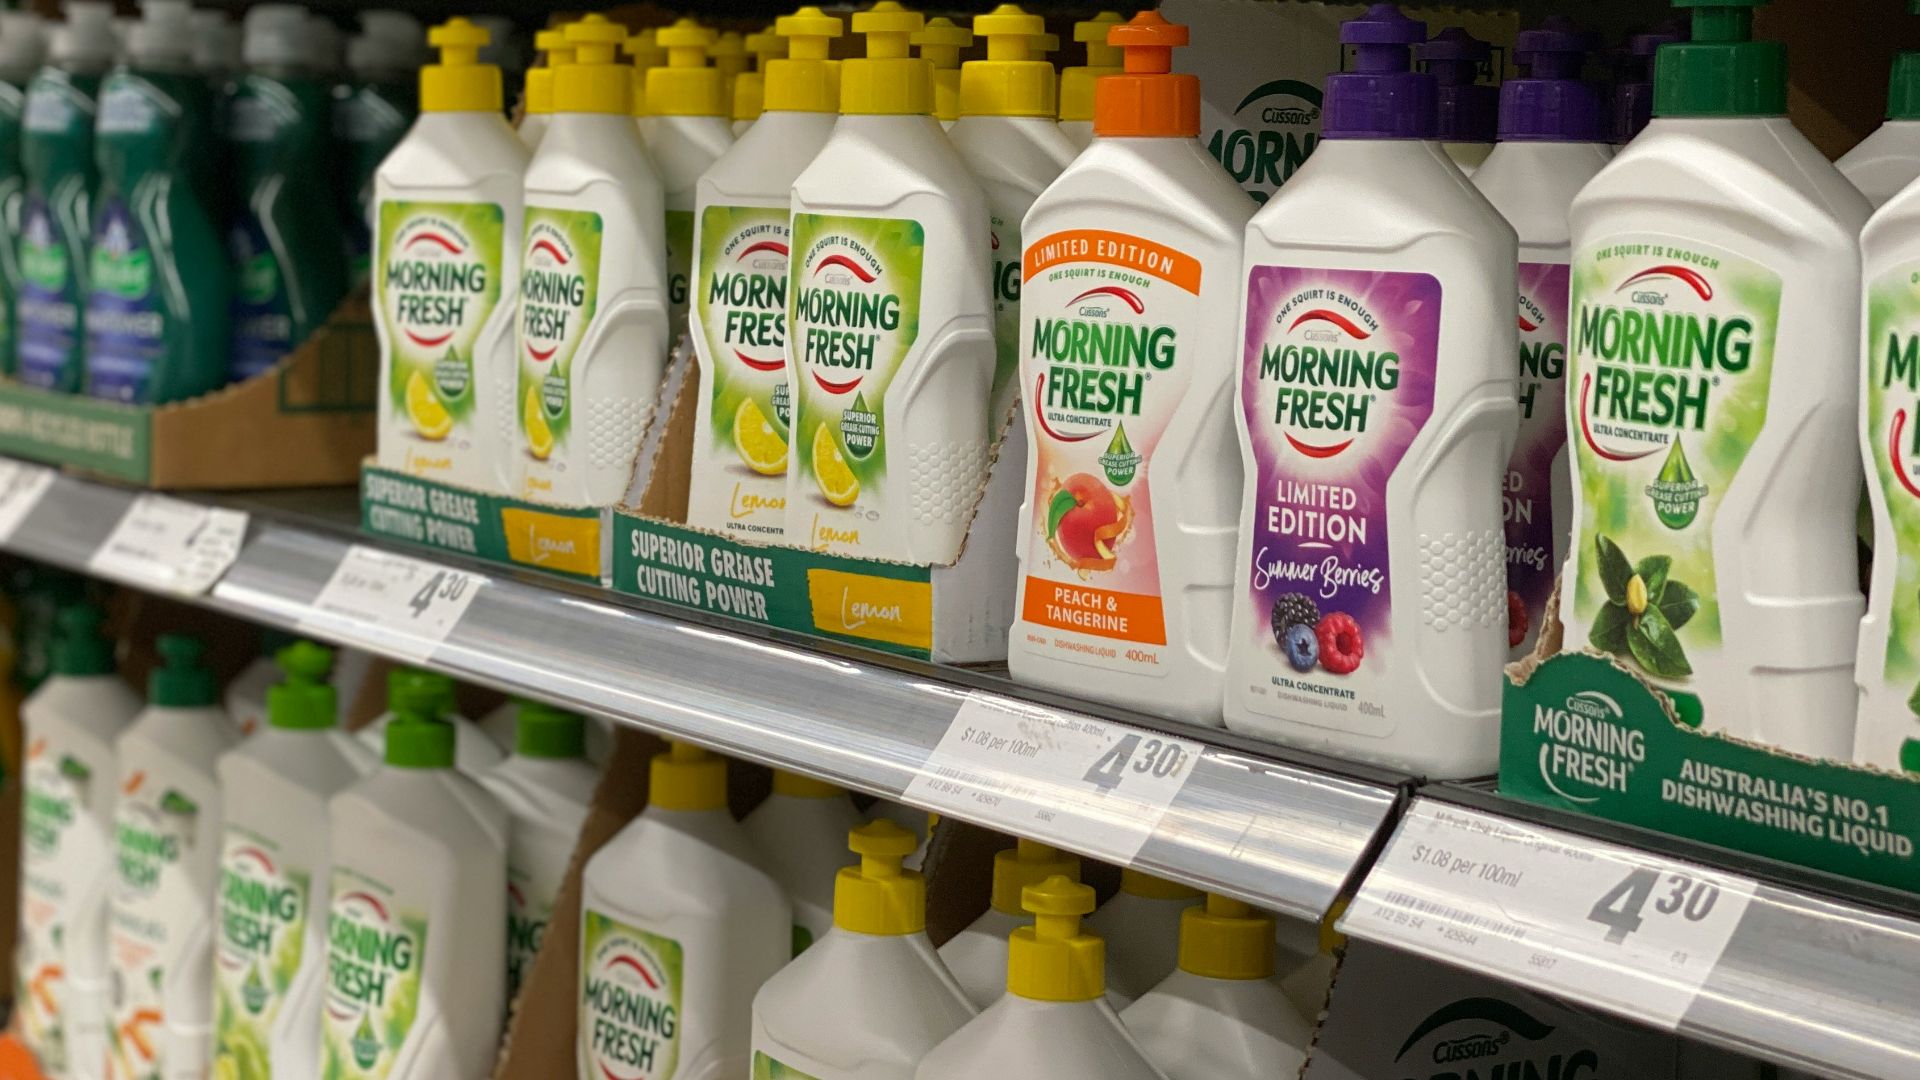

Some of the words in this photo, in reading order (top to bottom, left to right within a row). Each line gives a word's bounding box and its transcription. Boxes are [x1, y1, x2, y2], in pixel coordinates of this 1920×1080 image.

[1262, 108, 1312, 125] Cussons
[725, 237, 739, 256] ONE
[741, 225, 770, 240] SQUIRT
[774, 226, 781, 234] IS
[805, 249, 816, 268] ONE
[816, 236, 839, 251] SQUIRT
[840, 237, 848, 246] IS
[850, 240, 883, 275] ENOUGH
[1034, 239, 1088, 267] LIMITED
[1097, 240, 1174, 275] EDITION
[1597, 248, 1612, 261] ONE
[1615, 244, 1650, 258] SQUIRT
[1653, 246, 1663, 256] IS
[1667, 248, 1719, 269] ENOUGH
[385, 259, 486, 293] MORNING
[1049, 270, 1062, 282] ONE
[1065, 268, 1096, 279] SQUIRT
[1097, 268, 1106, 278] IS
[1109, 271, 1151, 288] ENOUGH
[397, 294, 463, 326] FRESH
[795, 287, 900, 331] MORNING
[1079, 306, 1108, 318] Cussons
[1276, 303, 1291, 323] ONE
[1293, 290, 1324, 306] SQUIRT
[1326, 290, 1335, 300] IS
[1338, 294, 1378, 331] ENOUGH
[805, 328, 875, 370] FRESH
[1032, 318, 1176, 371] MORNING
[1578, 304, 1752, 373] MORNING
[1260, 343, 1400, 391] MORNING
[1882, 332, 1920, 391] M
[1047, 366, 1143, 416] FRESH
[1275, 387, 1370, 432] FRESH
[1593, 366, 1709, 431] FRESH
[843, 410, 876, 424] SUPERIOR
[1047, 413, 1065, 423] ULTRA
[1066, 415, 1112, 428] CONCENTRATE
[1593, 423, 1613, 436] ULTRA
[1614, 427, 1669, 444] CONCENTRATE
[846, 434, 873, 447] POWER
[1107, 466, 1134, 476] POWER
[429, 489, 480, 525] GREASE
[1277, 480, 1356, 510] LIMITED
[1658, 501, 1695, 514] POWER
[425, 517, 477, 553] POWER
[529, 524, 577, 563] Lemon
[726, 522, 745, 532] ULTRA
[811, 513, 860, 552] Lemon
[1268, 506, 1366, 544] EDITION
[631, 529, 705, 574] SUPERIOR
[711, 547, 775, 588] GREASE
[1254, 547, 1317, 590] Summer
[1320, 556, 1384, 598] Berries
[637, 565, 700, 606] CUTTING
[706, 580, 769, 621] POWER
[841, 585, 903, 630] Lemon
[1055, 586, 1101, 609] PEACH
[1106, 597, 1118, 611] &
[1046, 604, 1128, 633] TANGERINE
[1094, 646, 1116, 658] LIQUID
[1125, 649, 1159, 664] 400mL
[1272, 676, 1294, 688] ULTRA
[1297, 682, 1355, 700] CONCENTRATE
[1566, 696, 1606, 719] Cussons
[962, 726, 990, 746] $1.08
[987, 737, 1009, 750] per
[1007, 739, 1041, 758] 100ml
[1534, 704, 1645, 763] MORNING
[1552, 743, 1627, 793] FRESH
[1680, 758, 1828, 814] AUSTRALIA'S
[1833, 797, 1889, 828] NO.1
[1662, 778, 1824, 838] DISHWASHING
[1829, 819, 1913, 858] LIQUID
[1413, 844, 1452, 868] $1.08
[1450, 856, 1477, 875] per
[1478, 863, 1524, 888] 100ml
[584, 974, 676, 1040] MORNING
[593, 1017, 656, 1074] FRESH
[1433, 1036, 1500, 1064] Cussons
